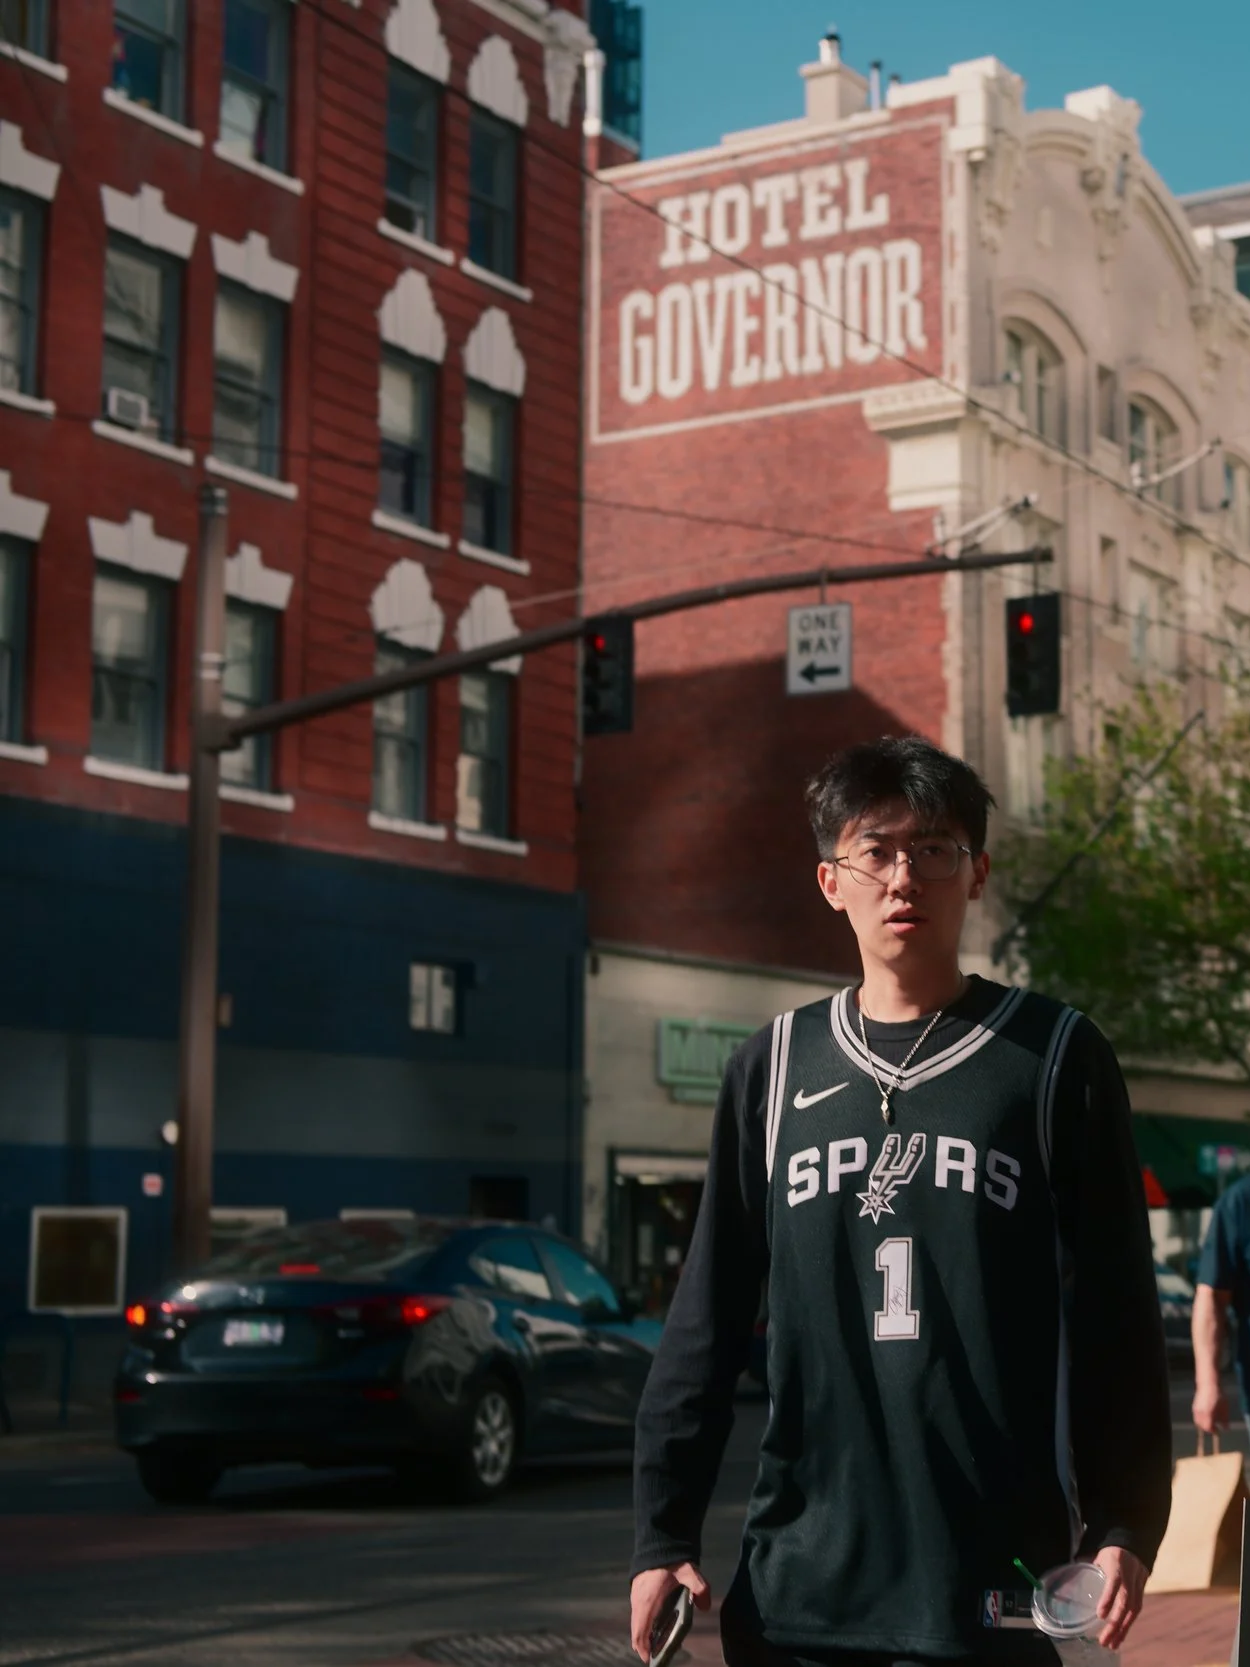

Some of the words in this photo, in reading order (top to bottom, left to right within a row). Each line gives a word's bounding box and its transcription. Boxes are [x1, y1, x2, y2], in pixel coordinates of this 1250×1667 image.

[657, 157, 890, 270] HOTEL
[619, 237, 928, 405] GOVERNOR
[797, 635, 843, 656] WAY
[798, 611, 839, 633] ONE
[787, 1132, 1021, 1225] SPURS
[874, 1236, 920, 1341] 1
